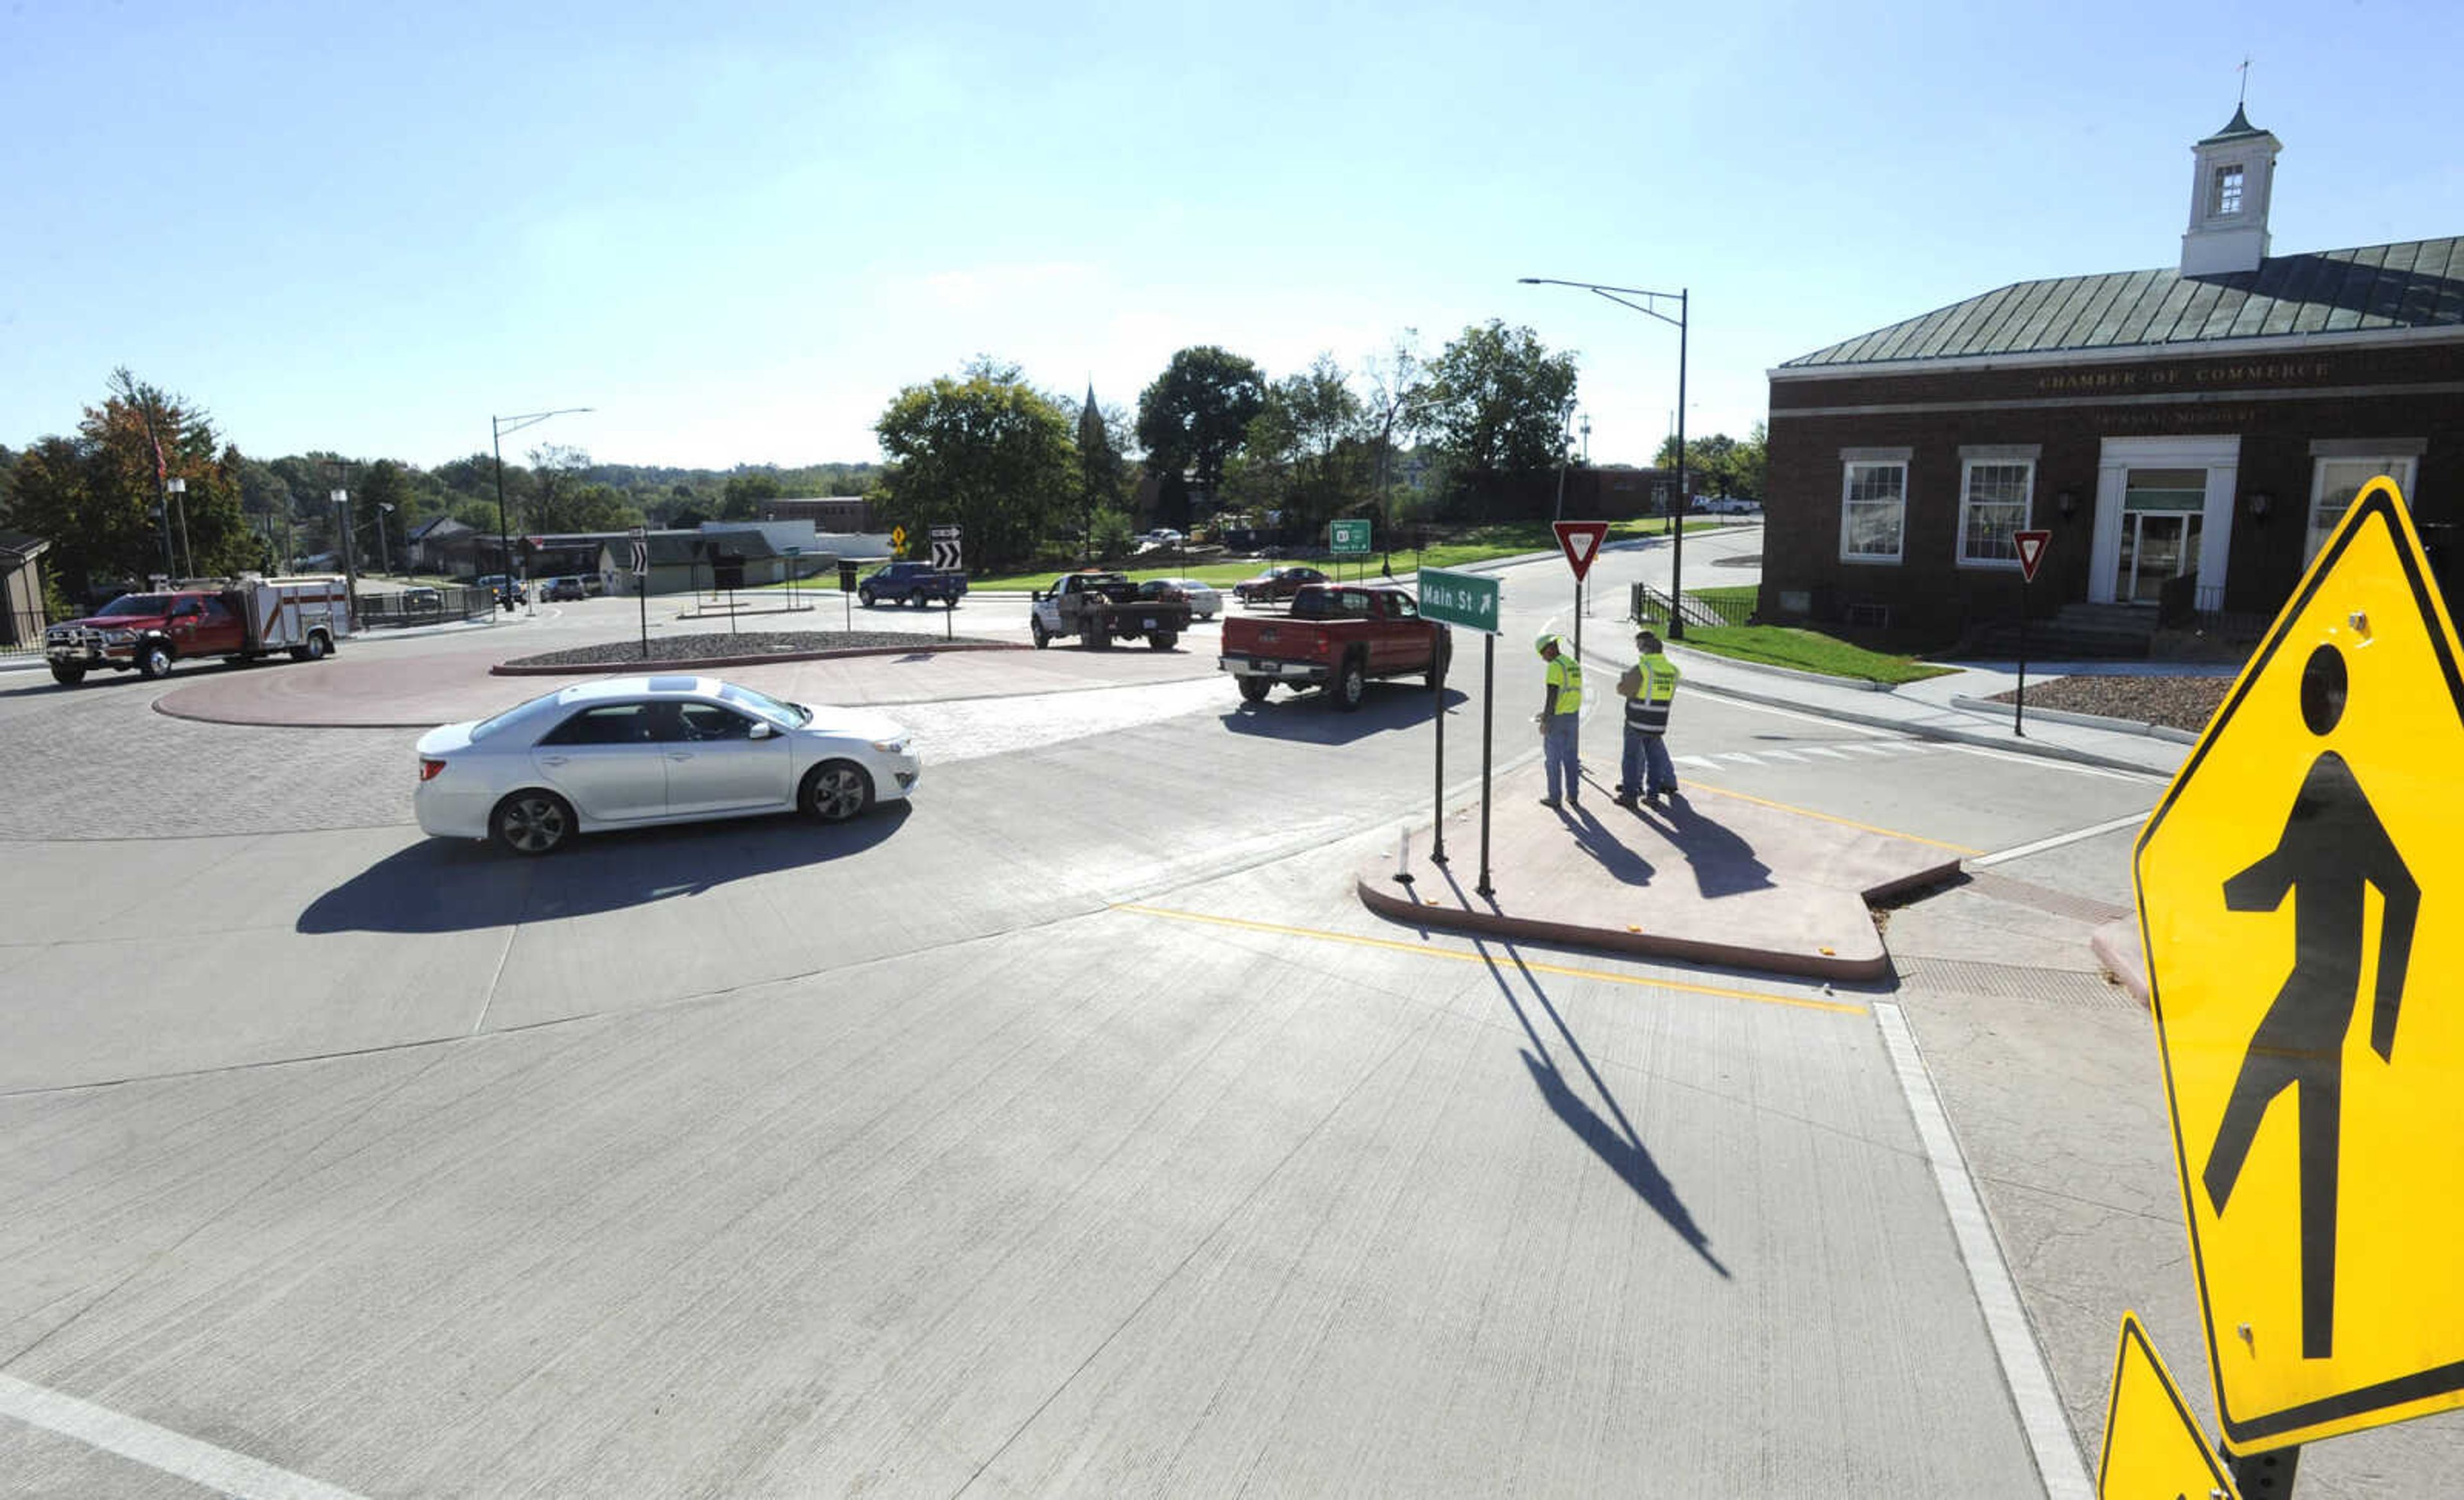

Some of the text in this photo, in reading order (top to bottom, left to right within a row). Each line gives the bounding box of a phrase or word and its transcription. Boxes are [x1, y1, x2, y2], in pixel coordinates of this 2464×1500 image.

[2039, 362, 2331, 389] CHAMBER OF COMMERCE
[1423, 584, 1473, 611] Main St
